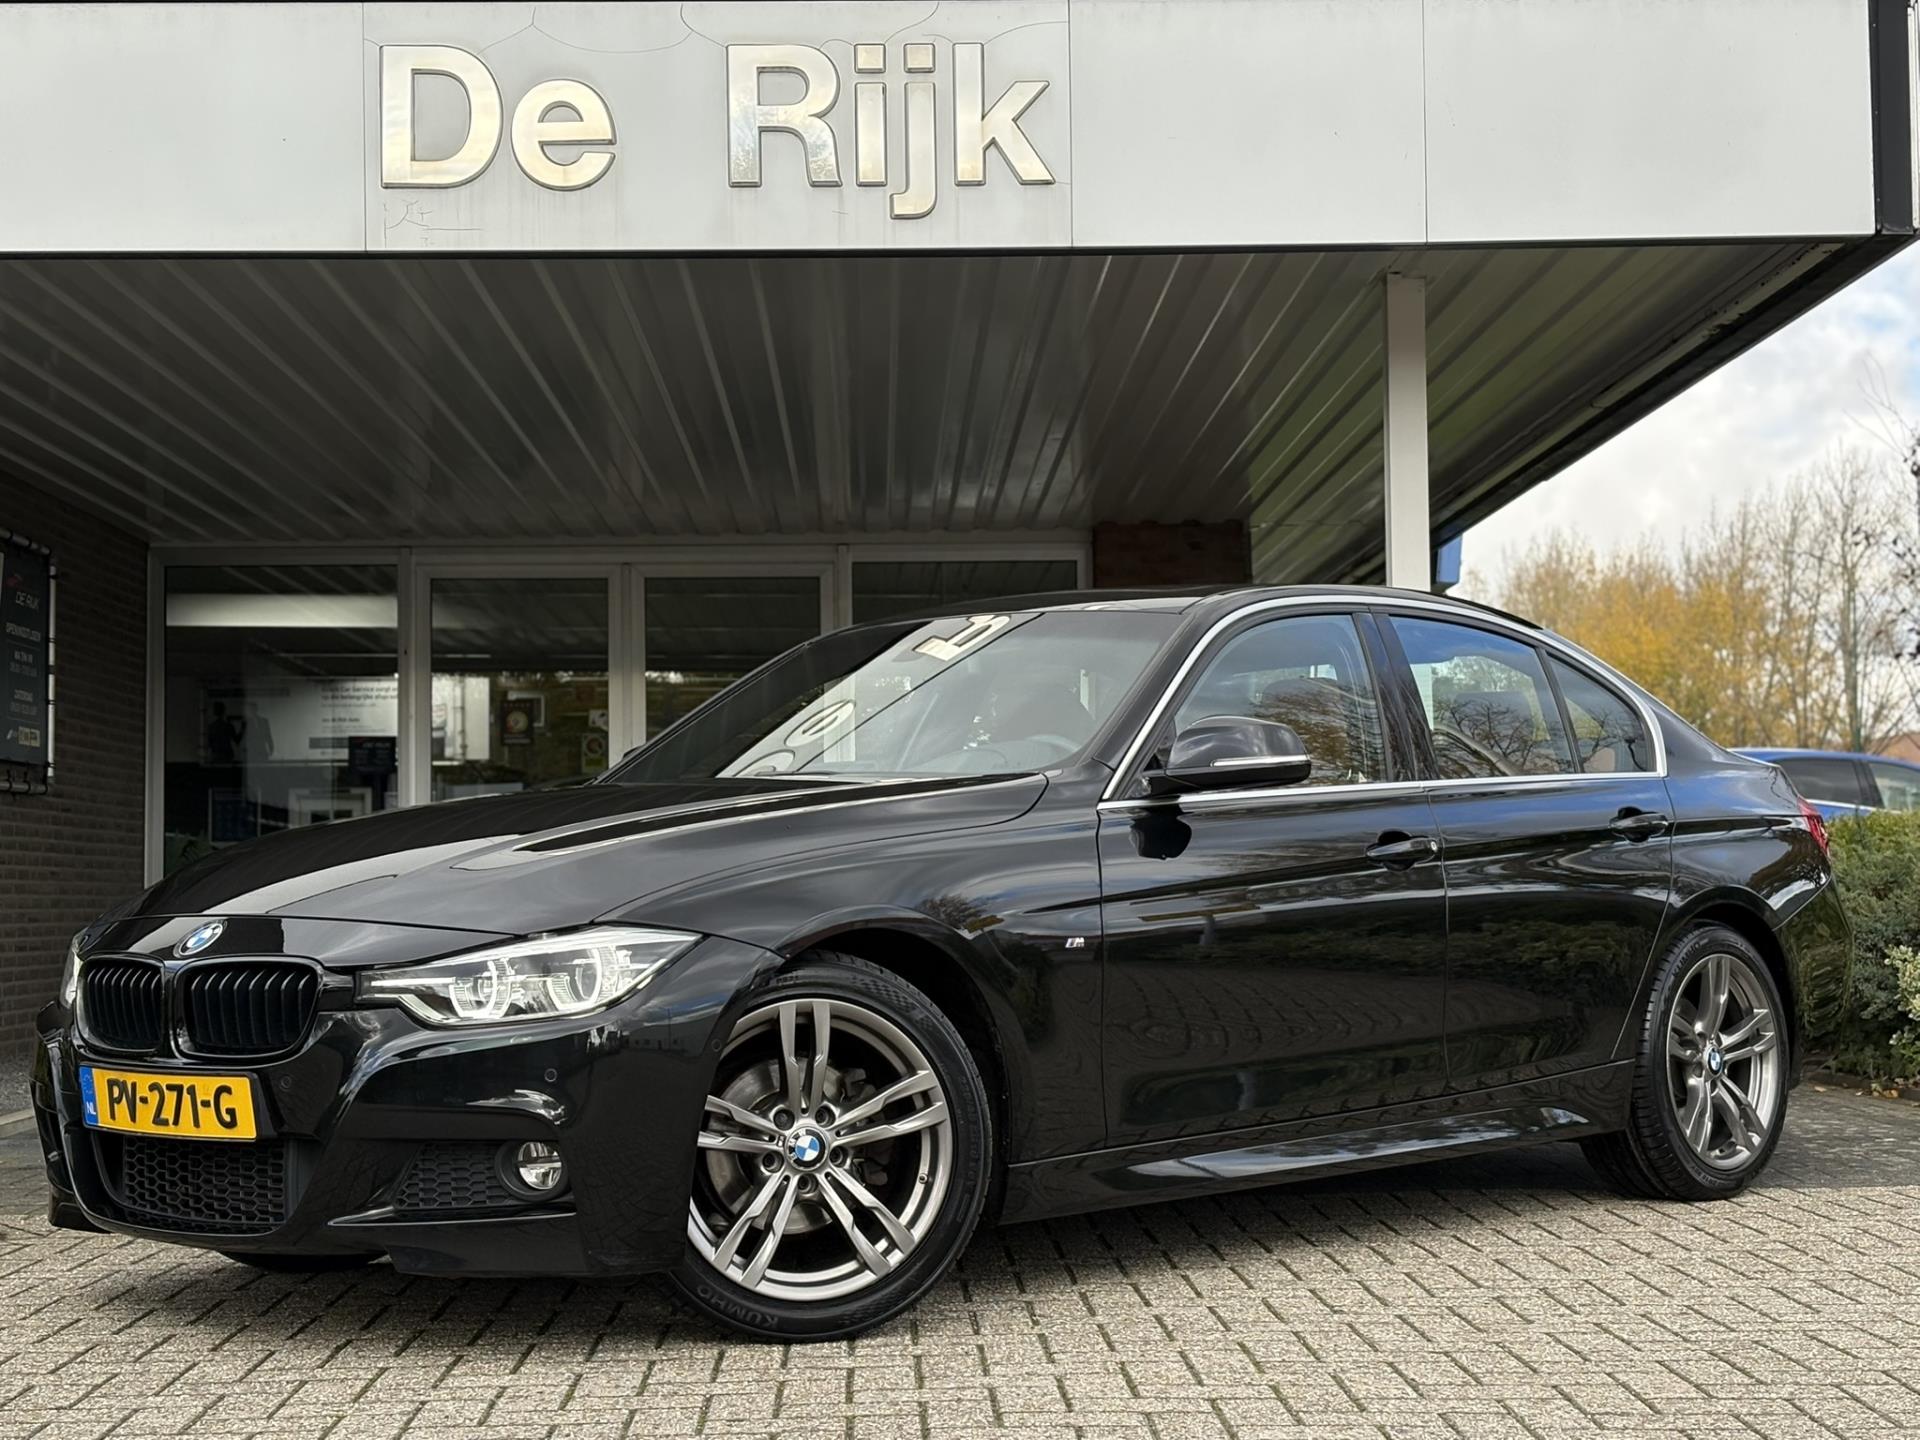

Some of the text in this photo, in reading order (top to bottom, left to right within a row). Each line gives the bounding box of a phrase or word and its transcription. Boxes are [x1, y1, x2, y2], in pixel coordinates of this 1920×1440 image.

[379, 43, 1056, 220] De Rijk
[86, 1101, 97, 1115] NL
[107, 1078, 238, 1129] PV-271-G
[697, 1284, 779, 1328] KUMHO
